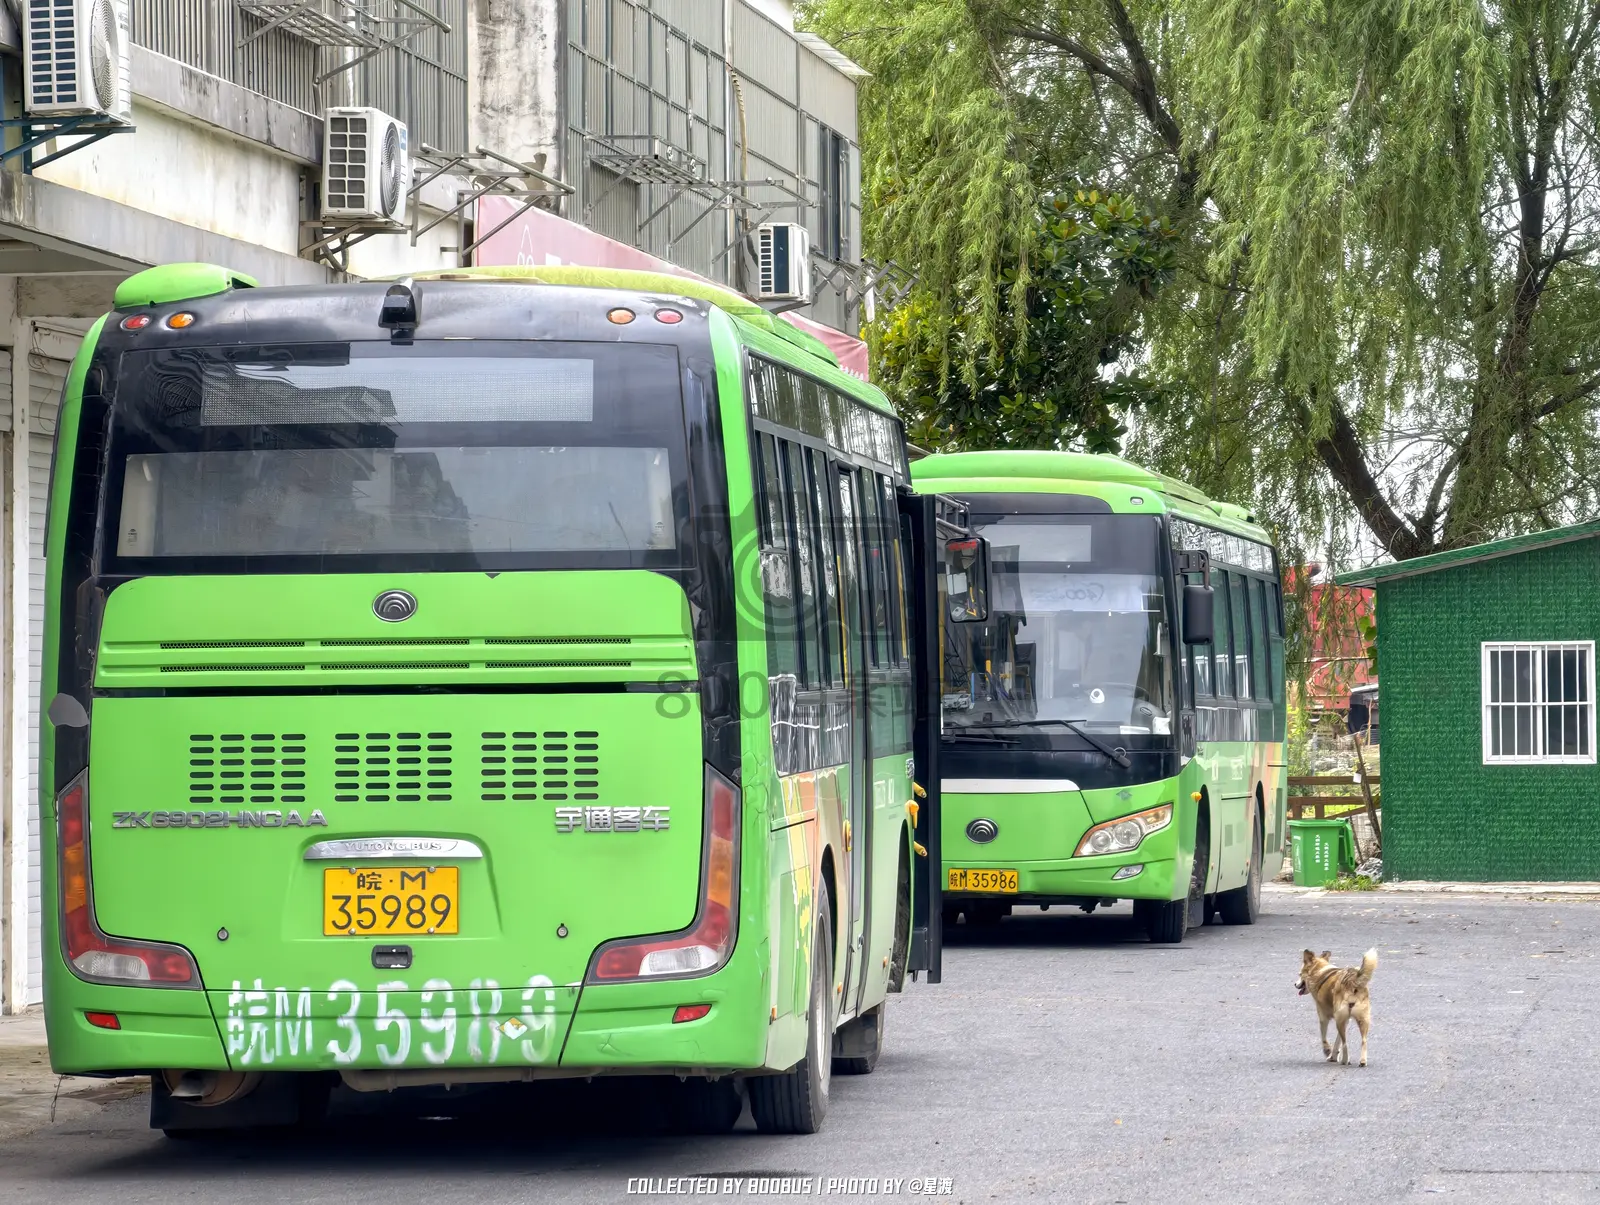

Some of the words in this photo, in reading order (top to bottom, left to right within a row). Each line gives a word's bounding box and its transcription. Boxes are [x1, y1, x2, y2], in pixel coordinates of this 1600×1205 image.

[112, 809, 329, 829] ZK6902HNGAA
[555, 805, 671, 833] 宇通客车
[344, 841, 407, 852] YUTONG
[410, 841, 443, 851] BUS
[331, 894, 452, 930] 35989
